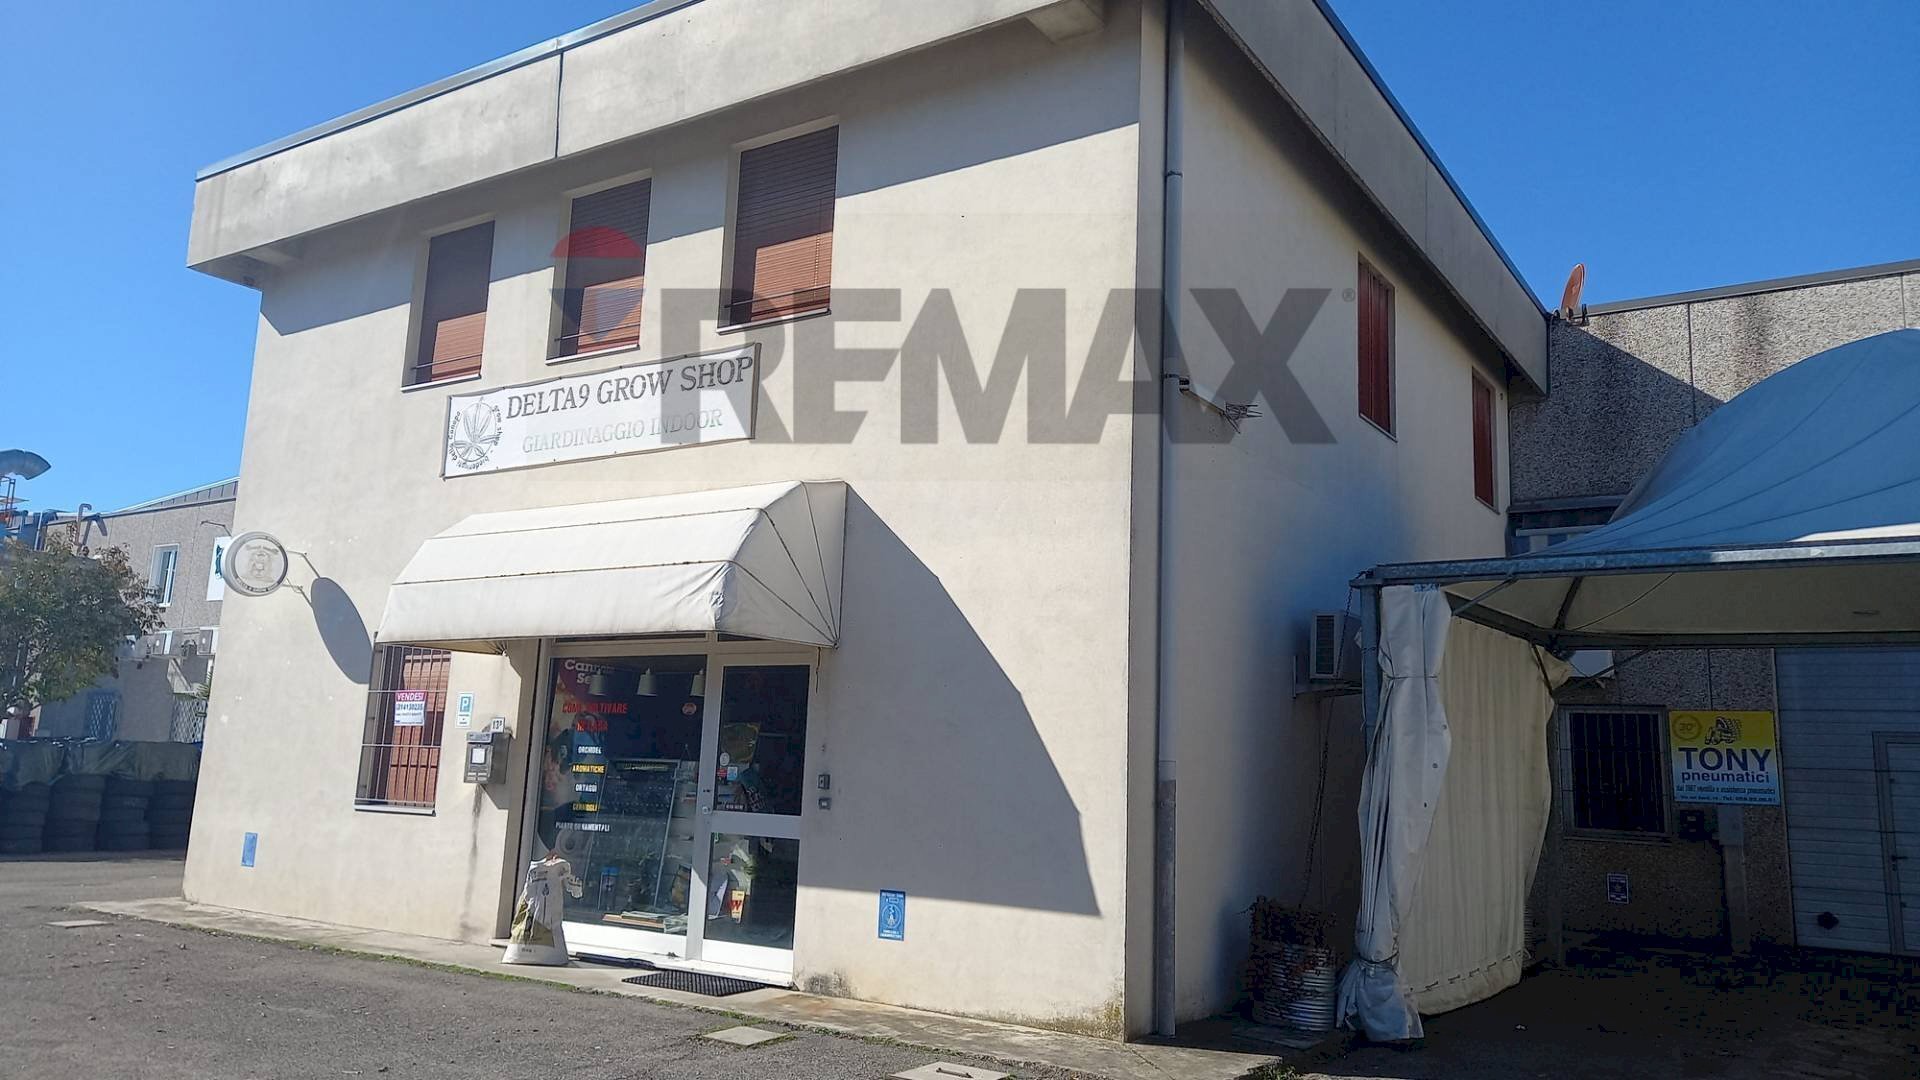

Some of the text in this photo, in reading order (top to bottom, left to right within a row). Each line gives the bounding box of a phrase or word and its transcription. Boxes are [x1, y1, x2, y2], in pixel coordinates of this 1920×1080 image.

[506, 356, 753, 419] DELTA9 GROW SHOP
[523, 409, 723, 453] GIARDINAGGIO INDOOR
[397, 692, 424, 700] VENDESI
[1678, 747, 1771, 771] TONY
[572, 764, 605, 773] AROMATICHE
[1681, 771, 1769, 783] pneumatici
